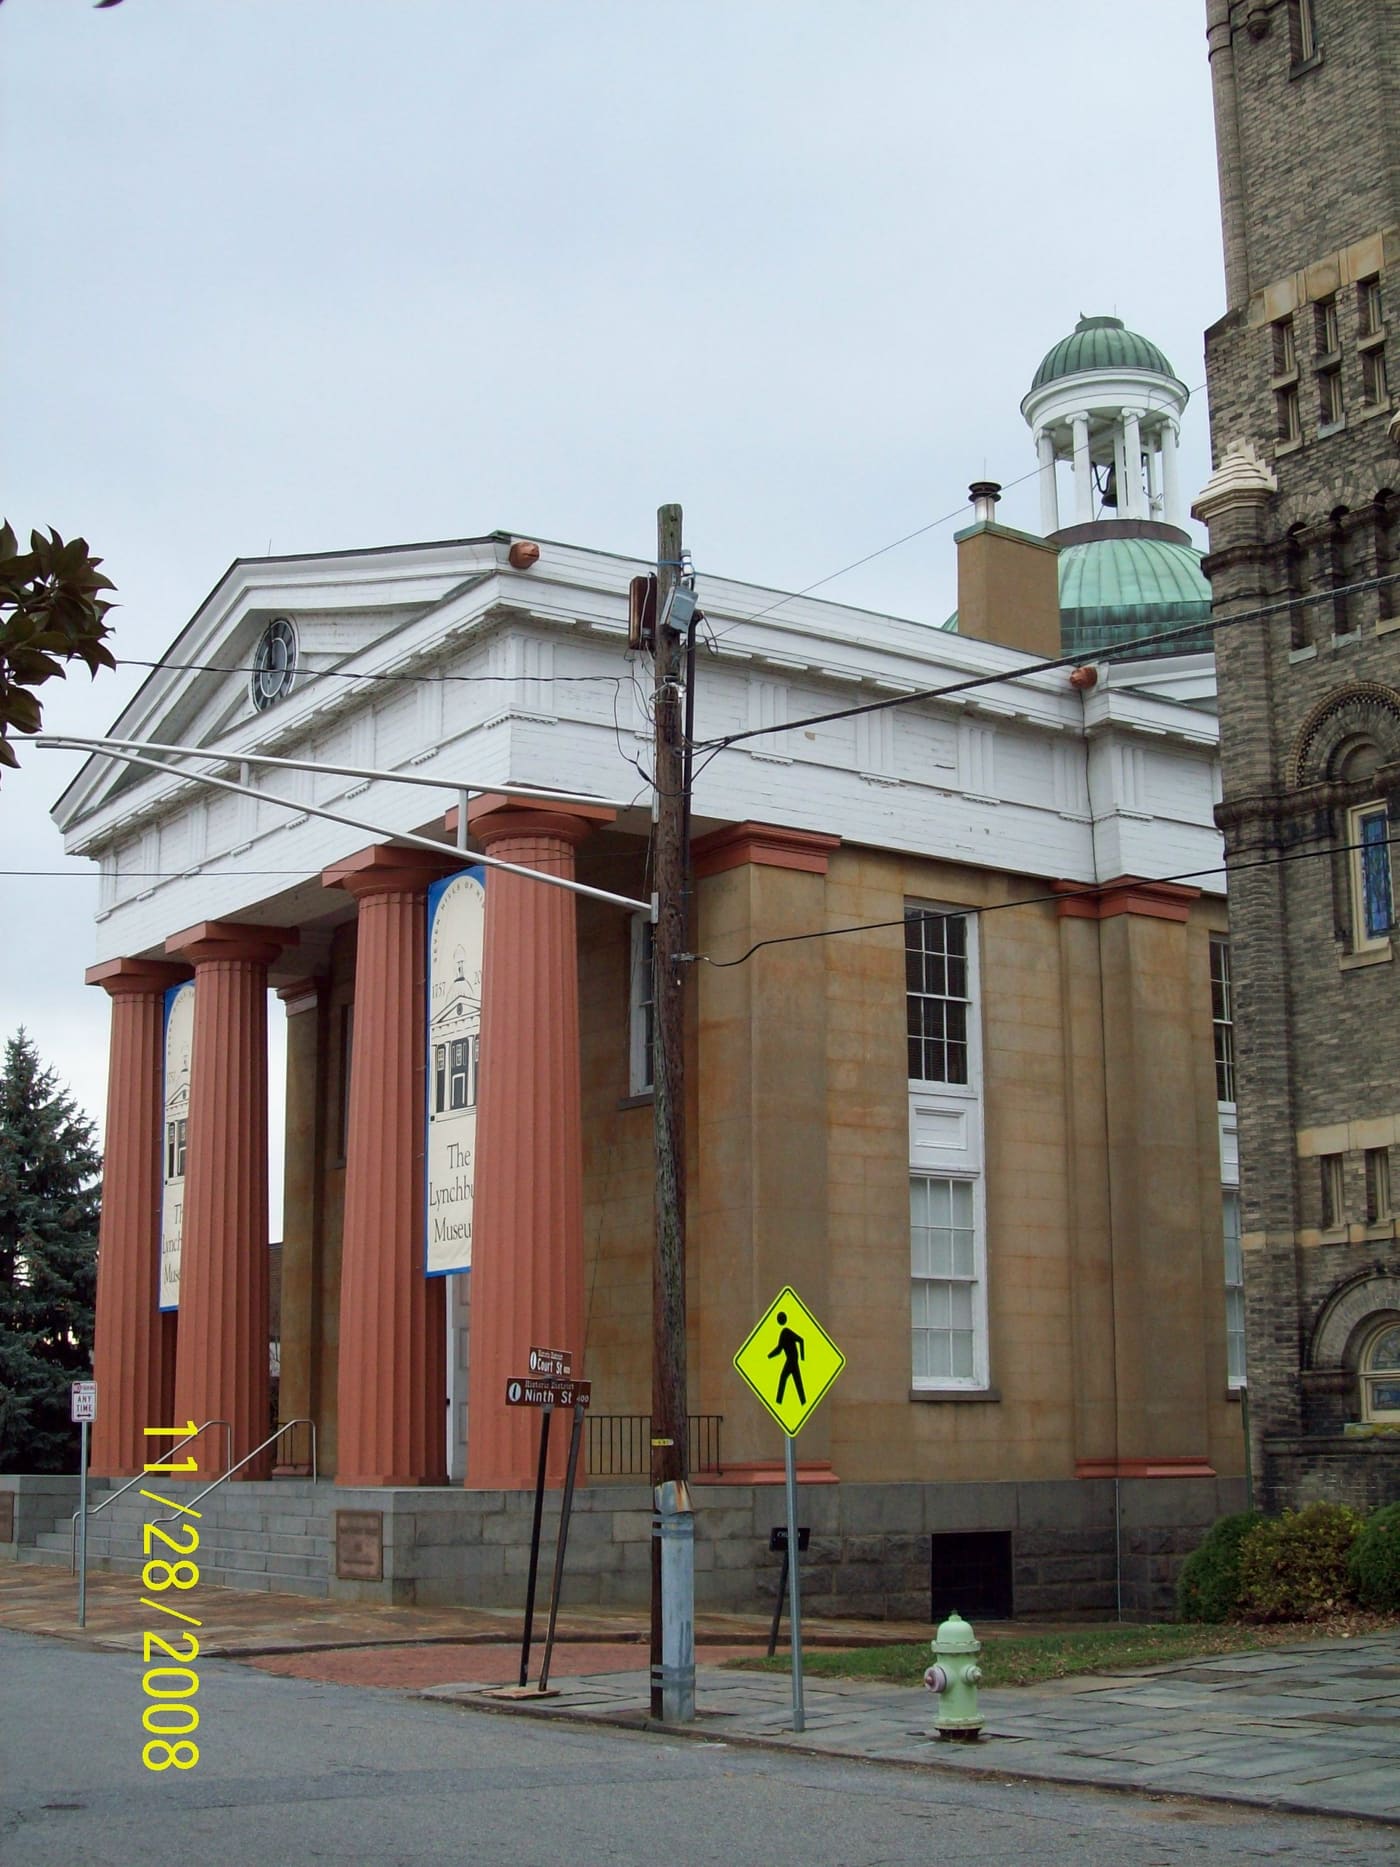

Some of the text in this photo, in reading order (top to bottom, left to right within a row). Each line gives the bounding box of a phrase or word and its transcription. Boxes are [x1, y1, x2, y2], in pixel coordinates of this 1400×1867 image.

[447, 1142, 471, 1169] The
[429, 1175, 474, 1212] Lynchbu
[434, 1217, 472, 1243] Museu
[537, 1358, 553, 1373] Court
[556, 1361, 563, 1375] St
[525, 1389, 554, 1403] Ninth
[561, 1391, 572, 1404] St
[77, 1404, 92, 1412] TIME
